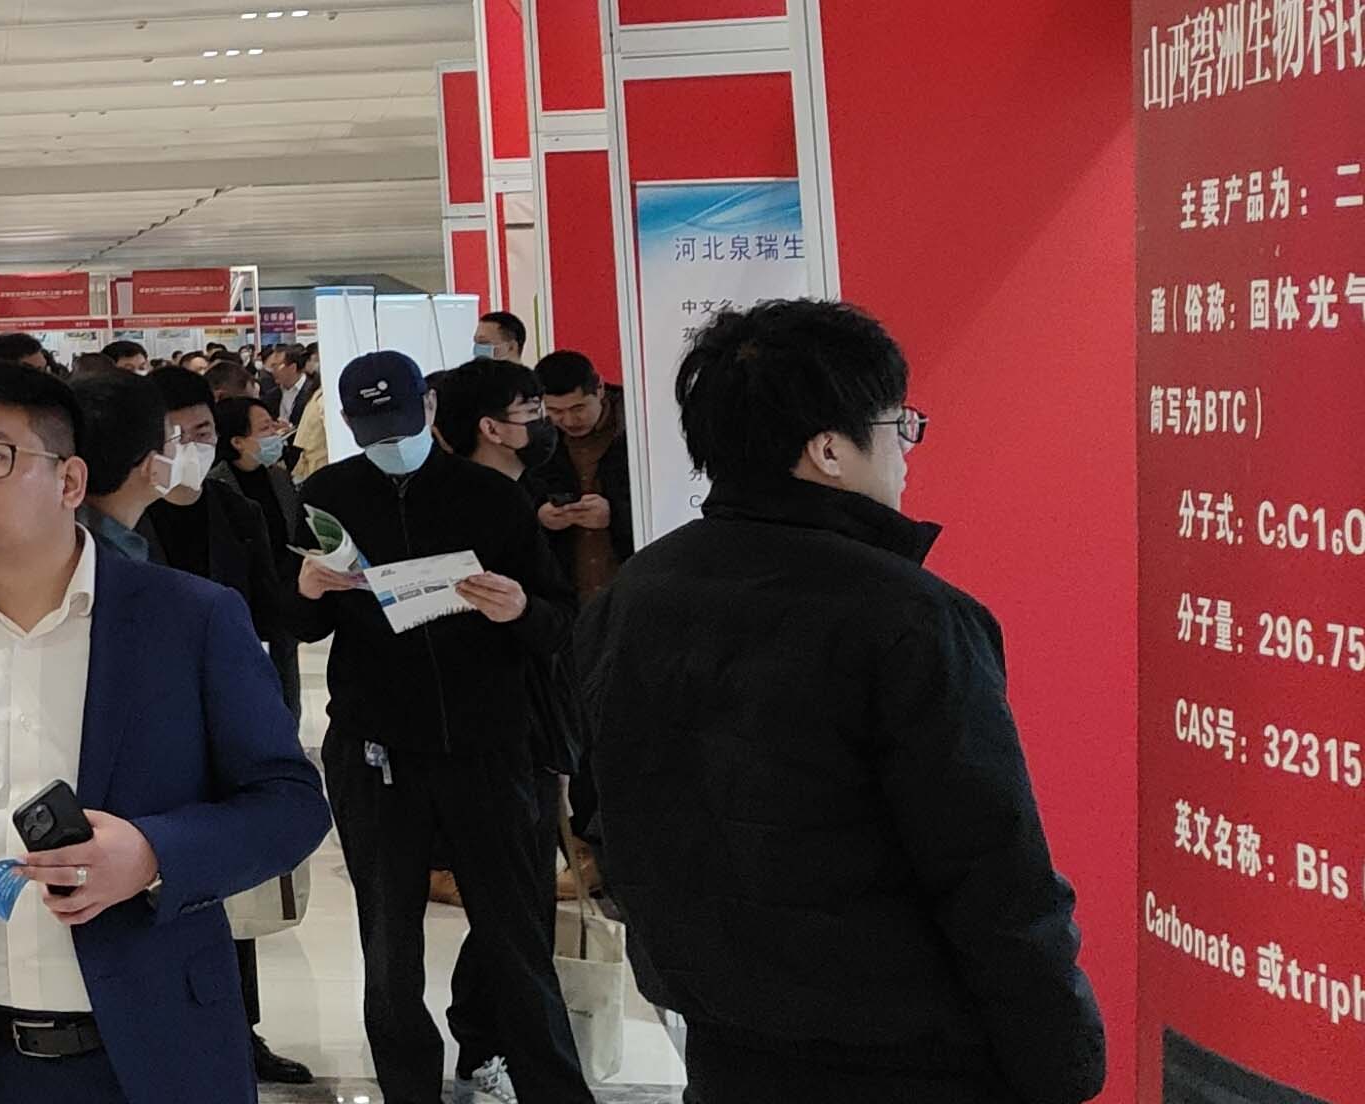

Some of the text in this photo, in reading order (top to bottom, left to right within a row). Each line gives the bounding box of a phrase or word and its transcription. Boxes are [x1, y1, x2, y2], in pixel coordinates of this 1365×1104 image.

[674, 233, 806, 262] 河北泉瑞生
[1258, 612, 1365, 672] 296.75
[1263, 723, 1363, 787] 32315
[1296, 842, 1350, 900] Bis
[1145, 890, 1247, 978] Carbonate
